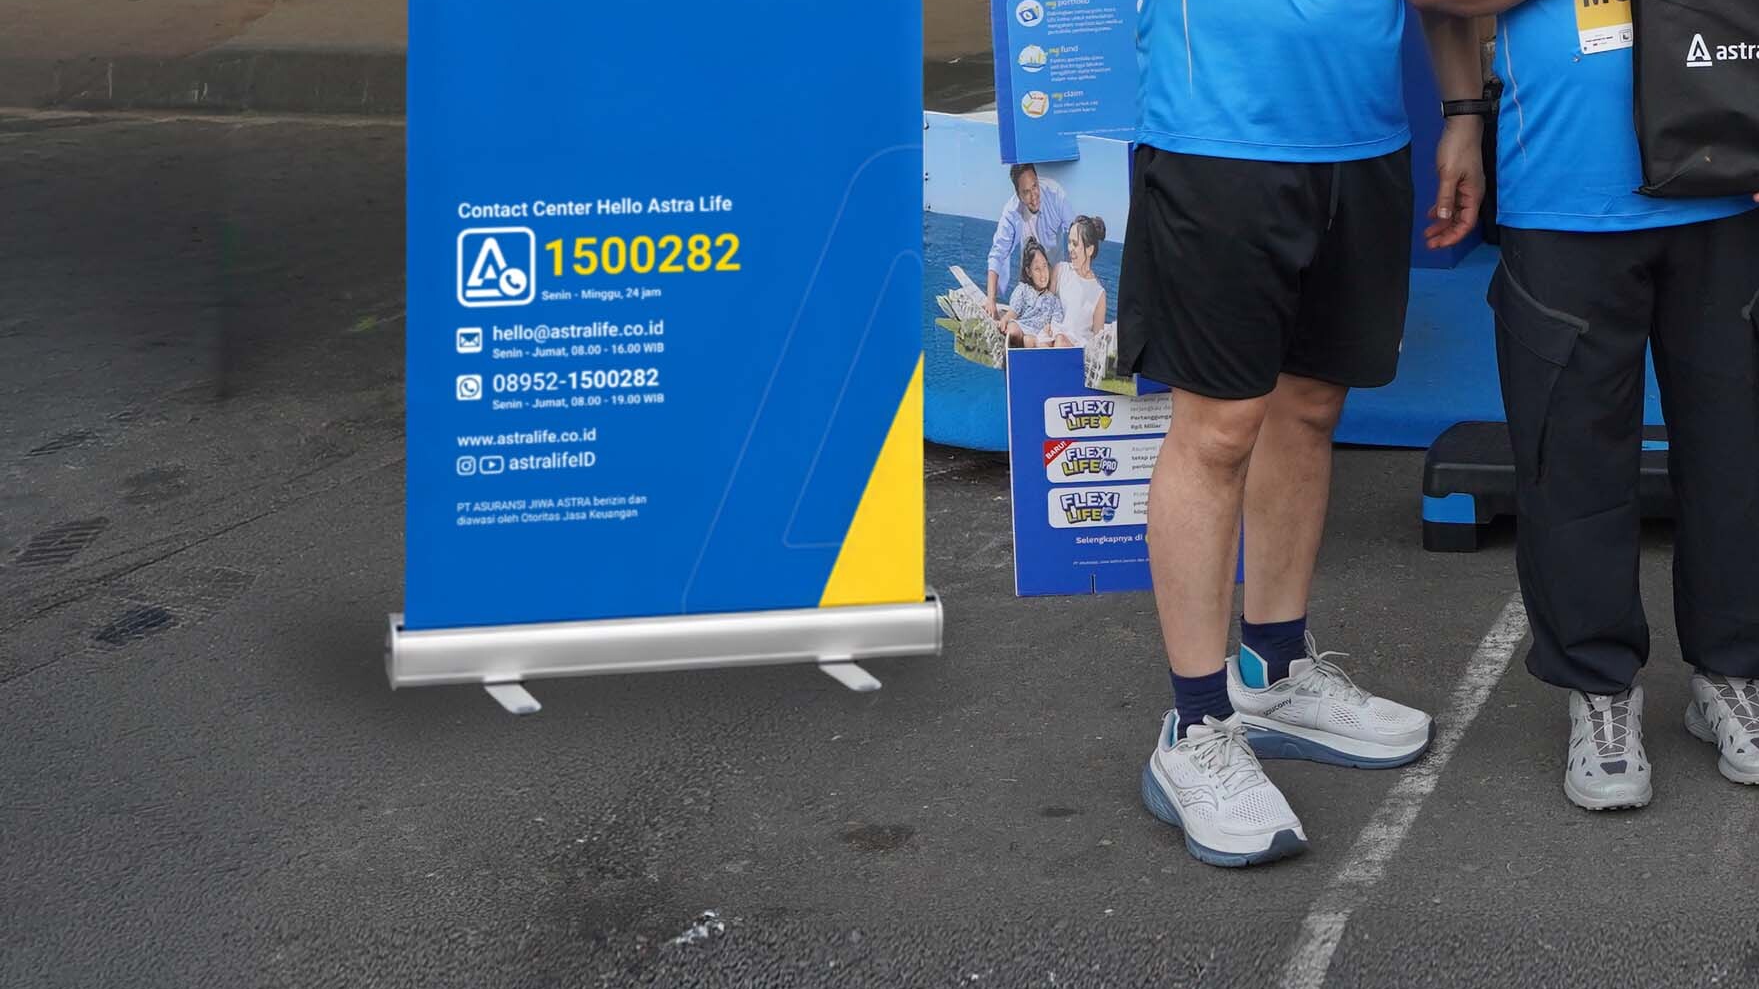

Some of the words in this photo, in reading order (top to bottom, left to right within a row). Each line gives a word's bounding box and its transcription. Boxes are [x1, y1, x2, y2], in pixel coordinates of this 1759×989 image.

[458, 203, 528, 219] Contact
[533, 200, 590, 216] Center
[597, 198, 642, 215] Hello
[648, 197, 694, 213] Astra
[699, 195, 733, 212] Life
[544, 233, 741, 276] 1500282
[541, 290, 571, 301] Senin
[581, 288, 624, 302] Minggu,
[626, 288, 639, 298] 24
[641, 288, 661, 300] jam
[493, 320, 664, 344] hello@astralife.co.id
[492, 347, 523, 359] Senin
[532, 346, 568, 358] Jumat,
[571, 345, 601, 356] 08.00
[612, 343, 641, 355] 16.00
[643, 342, 664, 353] WIB
[493, 367, 659, 393] 08952-1500282
[492, 399, 523, 410] Senin
[532, 397, 568, 409] Jumat,
[571, 396, 601, 407] 08.00
[612, 395, 641, 405] 19.00
[643, 394, 664, 404] WIB
[1059, 400, 1114, 418] FLEXI
[1066, 416, 1100, 431] LIFE
[457, 428, 597, 447] www.astralife.co.id
[1045, 440, 1067, 460] BARU!
[1065, 447, 1111, 462] FLEXI
[509, 451, 596, 471] astralifeID
[1062, 459, 1101, 476] LIFE
[1102, 460, 1117, 471] PRO
[457, 502, 471, 512] PT
[474, 499, 526, 512] ASURANSI
[528, 499, 554, 509] JIWA
[557, 496, 591, 508] ASTRA
[628, 494, 647, 504] dan
[1060, 492, 1120, 511] FLEXI
[457, 514, 496, 526] diawasi
[497, 513, 519, 524] oleh
[521, 511, 560, 522] Otoritas
[563, 511, 587, 521] Jasa
[589, 509, 638, 520] Keuangan
[1066, 508, 1101, 524] LIFE
[1076, 534, 1132, 545] Selengkapnya
[1135, 533, 1143, 541] di
